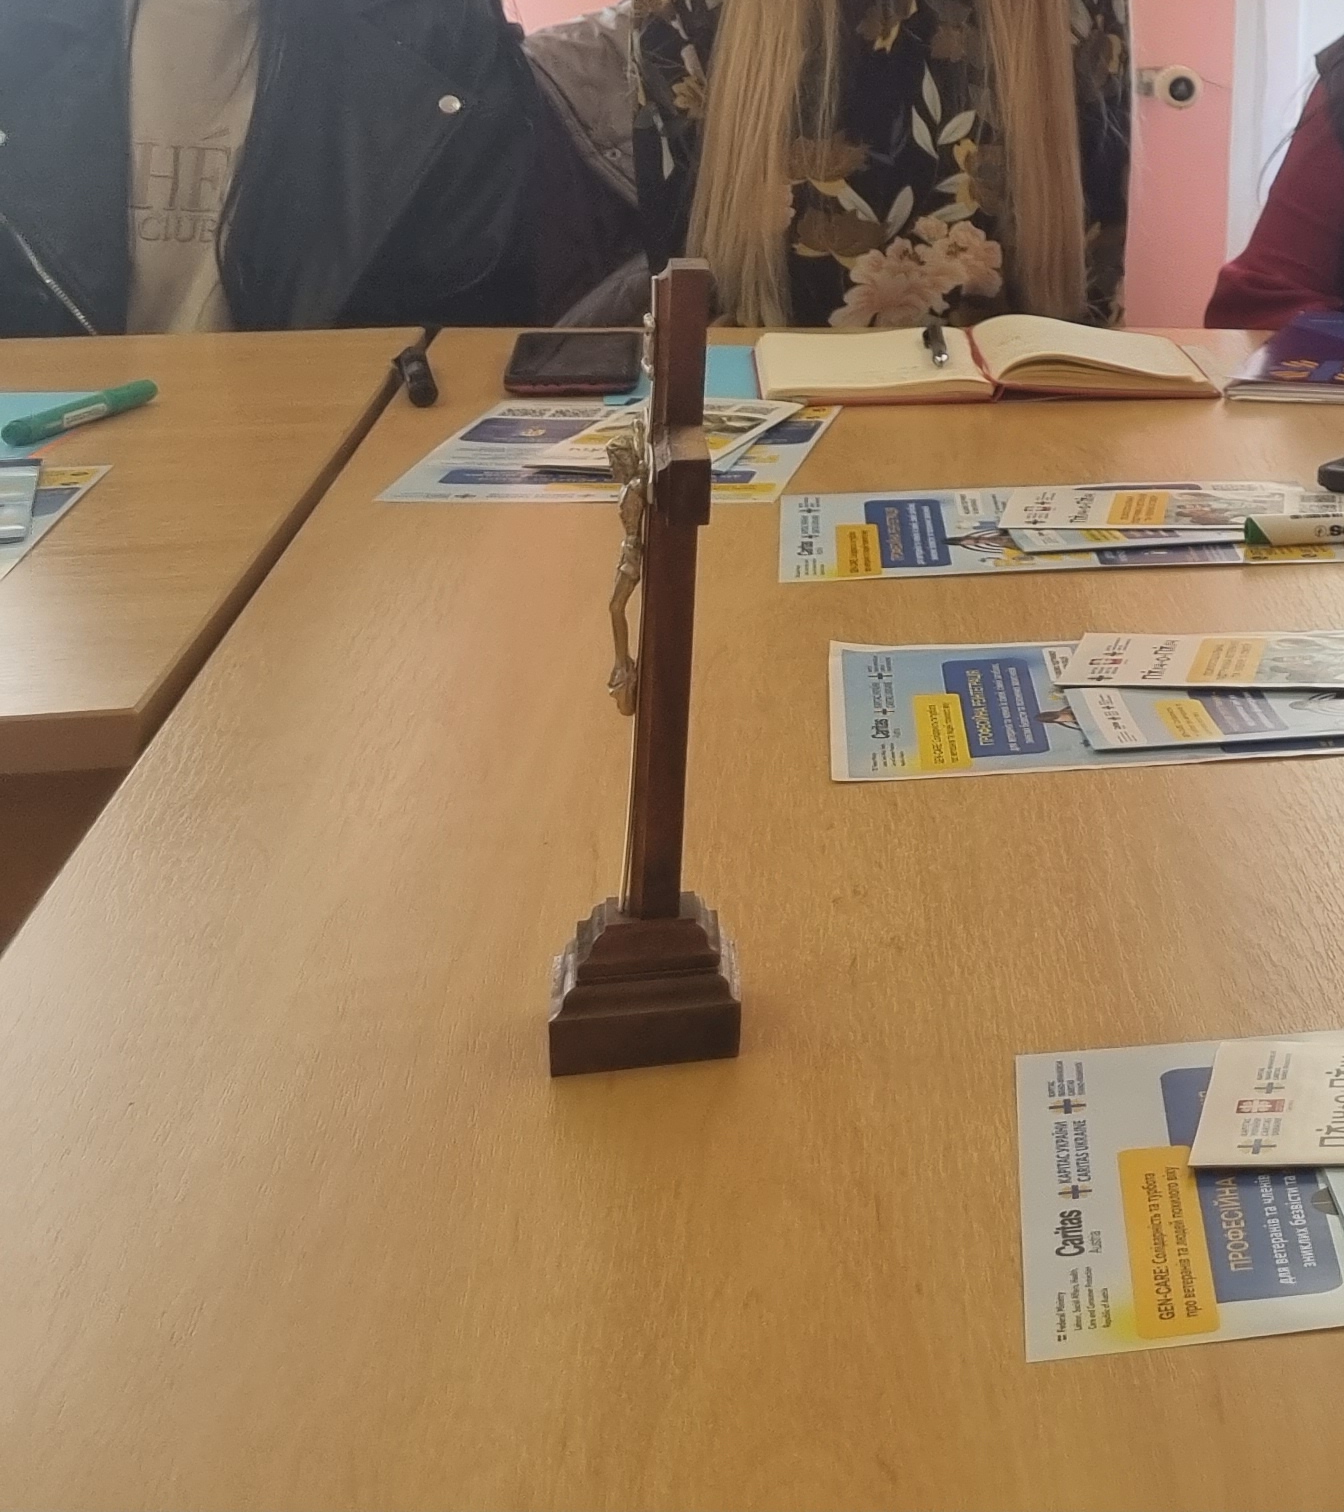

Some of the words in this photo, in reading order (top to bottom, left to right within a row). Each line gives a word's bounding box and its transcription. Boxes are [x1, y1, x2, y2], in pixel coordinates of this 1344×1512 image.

[1072, 1120, 1089, 1151] UKRAINE
[1075, 1152, 1091, 1182] CARITAS
[1162, 1166, 1179, 1180] віку
[1284, 1175, 1297, 1185] та
[1142, 1172, 1163, 1202] турбота
[1168, 1182, 1184, 1218] похилого
[1254, 1174, 1275, 1204] членів
[1148, 1203, 1160, 1212] та
[1263, 1206, 1278, 1216] та
[1285, 1187, 1307, 1226] безвісти
[1054, 1210, 1085, 1256] Caritas
[1147, 1213, 1168, 1264] Солідарність
[1212, 1176, 1254, 1271] ПРОФЕСІЙНА
[1088, 1230, 1102, 1254] Austria
[1177, 1247, 1189, 1256] та
[1262, 1218, 1289, 1264] ветеранів
[1295, 1227, 1316, 1268] зниклих
[1176, 1258, 1197, 1298] ветеранів
[1277, 1266, 1297, 1284] для
[1152, 1266, 1176, 1320] GEN-CARE:
[1184, 1300, 1202, 1317] про
